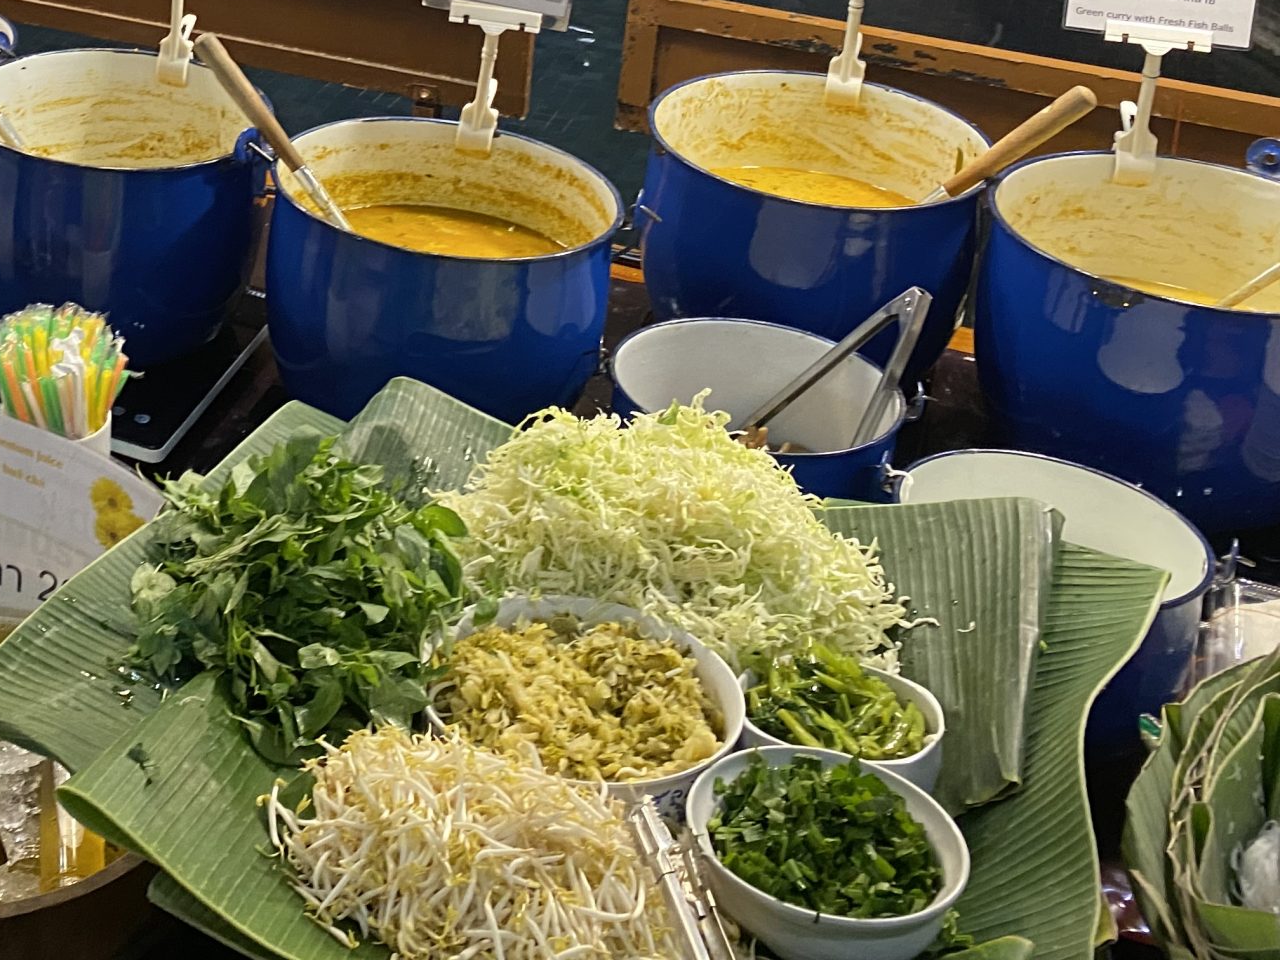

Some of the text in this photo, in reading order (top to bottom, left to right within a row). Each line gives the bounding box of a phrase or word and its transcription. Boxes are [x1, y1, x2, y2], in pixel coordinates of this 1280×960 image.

[1075, 6, 1234, 33] Green curry with Fresh Fish Balls
[37, 570, 69, 601] 2
